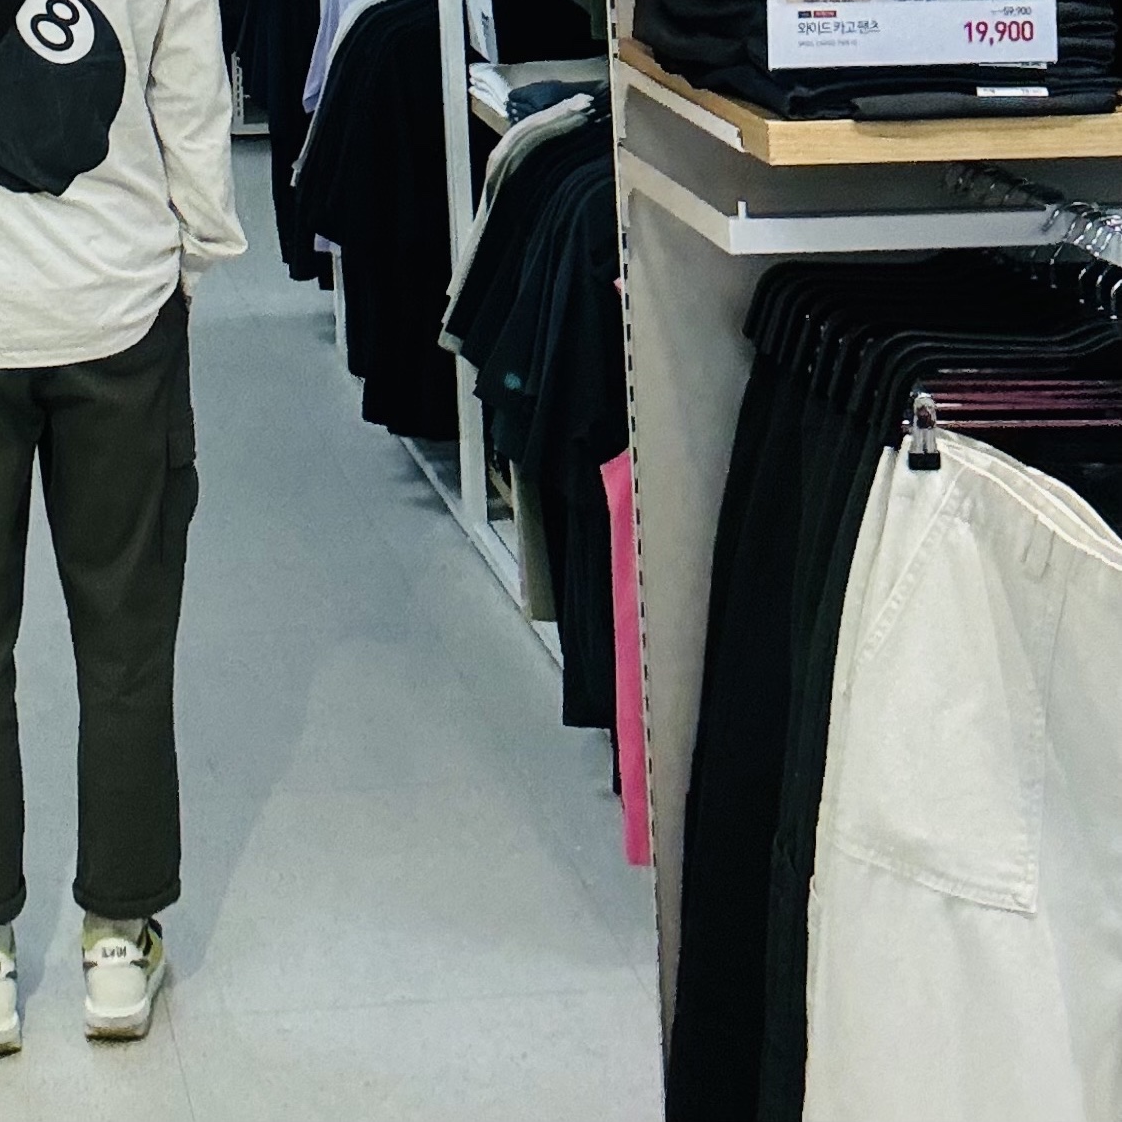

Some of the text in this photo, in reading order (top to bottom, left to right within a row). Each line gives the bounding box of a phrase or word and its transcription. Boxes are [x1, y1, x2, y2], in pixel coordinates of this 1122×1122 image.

[798, 21, 832, 35] 와이드
[833, 21, 856, 35] 카고
[964, 20, 1034, 46] 19,900
